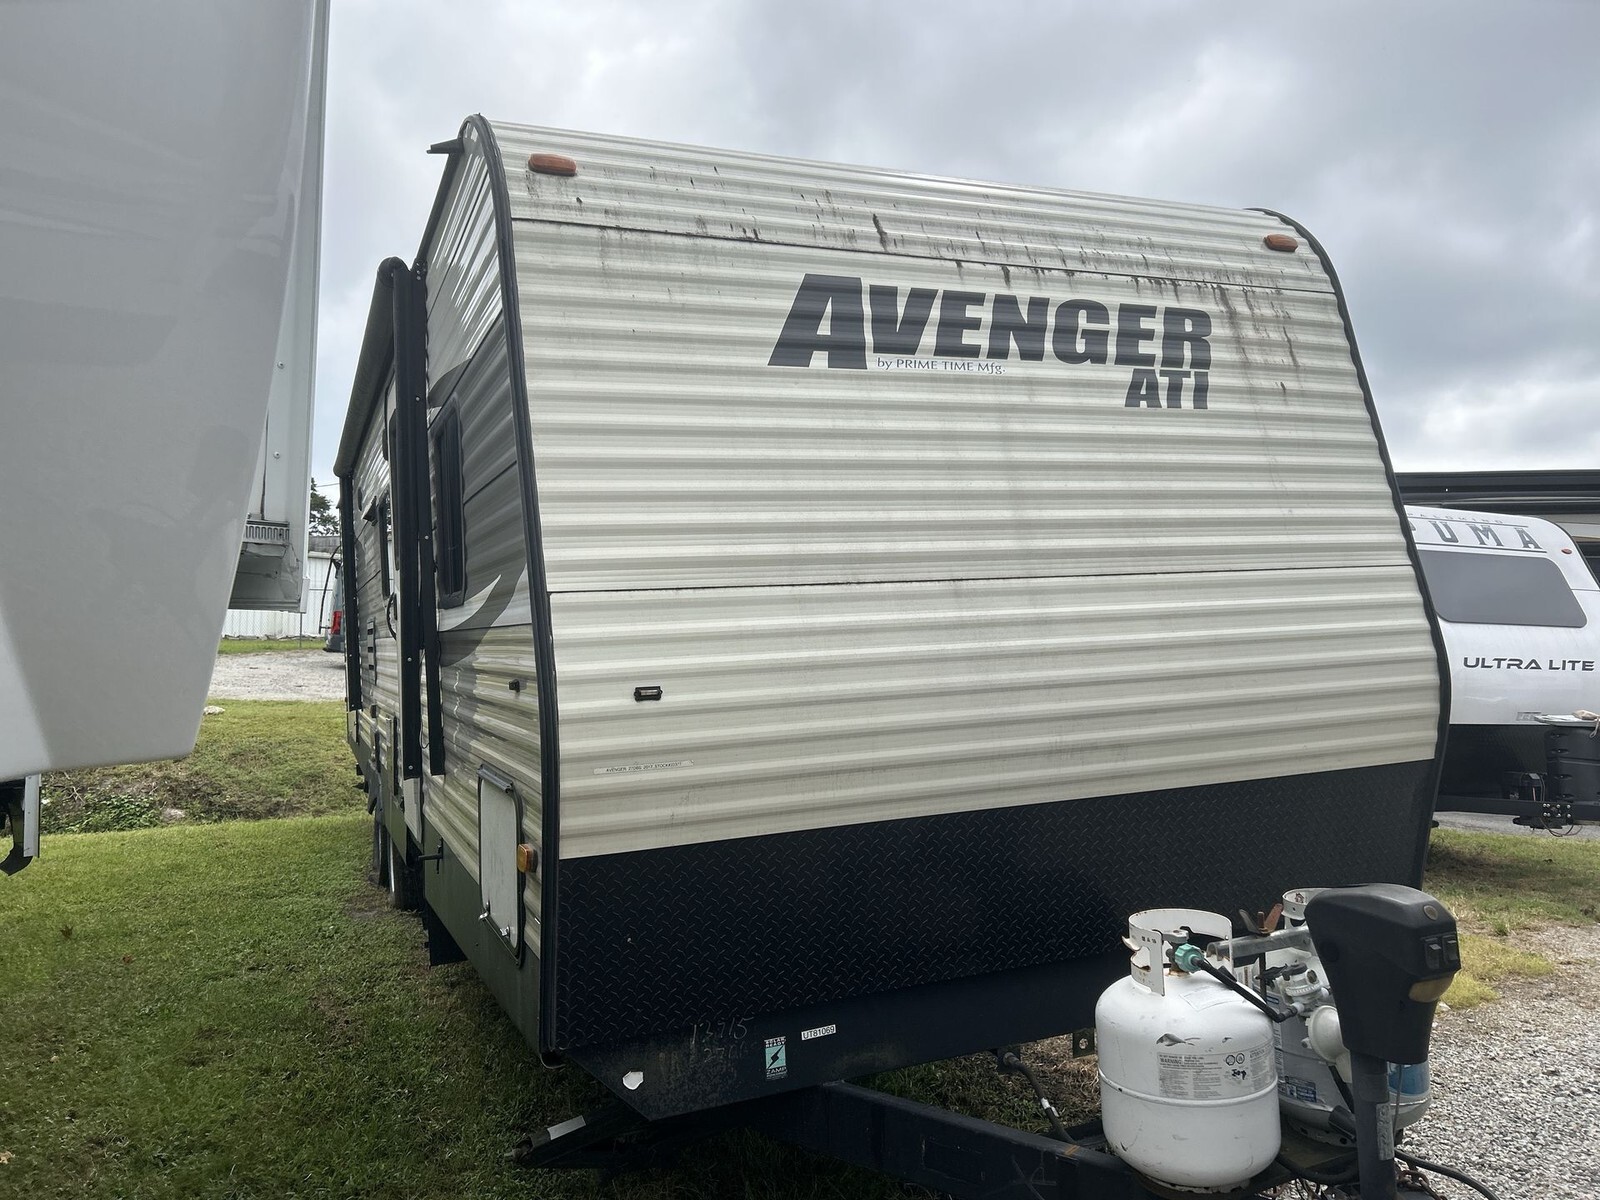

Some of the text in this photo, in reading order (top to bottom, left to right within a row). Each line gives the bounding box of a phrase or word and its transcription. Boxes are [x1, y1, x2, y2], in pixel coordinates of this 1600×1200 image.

[768, 273, 1212, 369] AVENGER
[876, 357, 1006, 374] by PRIME TIME Mfg.
[1124, 369, 1209, 409] ATI
[1408, 520, 1543, 549] UMA
[1463, 657, 1595, 672] ULTRA LITE
